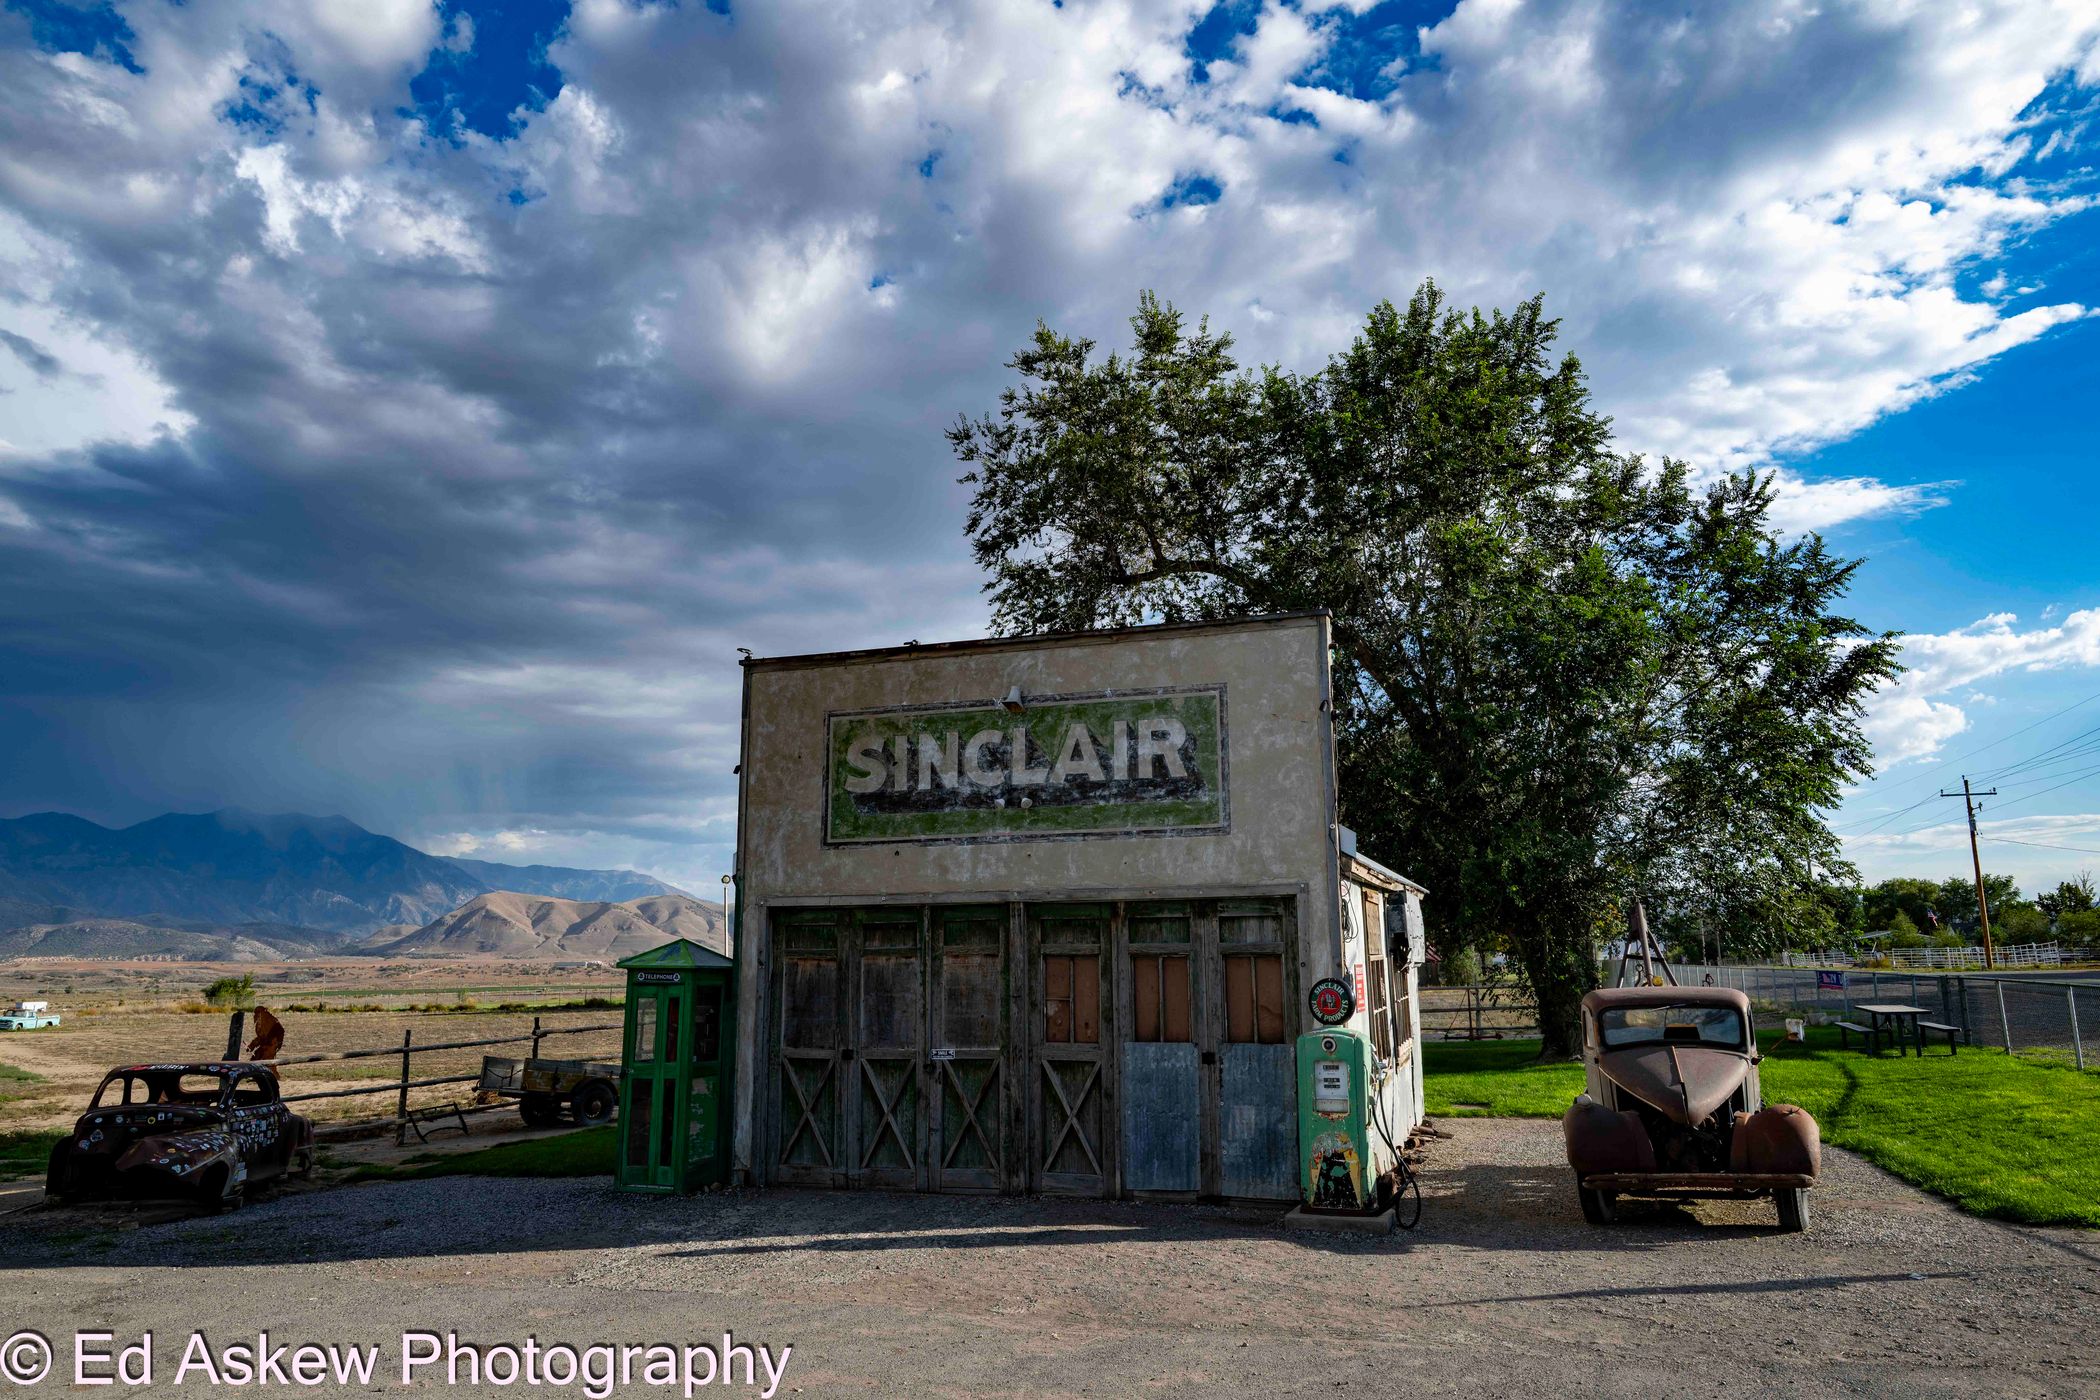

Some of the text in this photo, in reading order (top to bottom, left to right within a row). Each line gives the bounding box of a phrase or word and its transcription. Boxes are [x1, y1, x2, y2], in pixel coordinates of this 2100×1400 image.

[845, 718, 1188, 794] SINCLAIR
[1314, 982, 1345, 996] SINCLAIR
[1323, 1000, 1349, 1023] PRODUCTS
